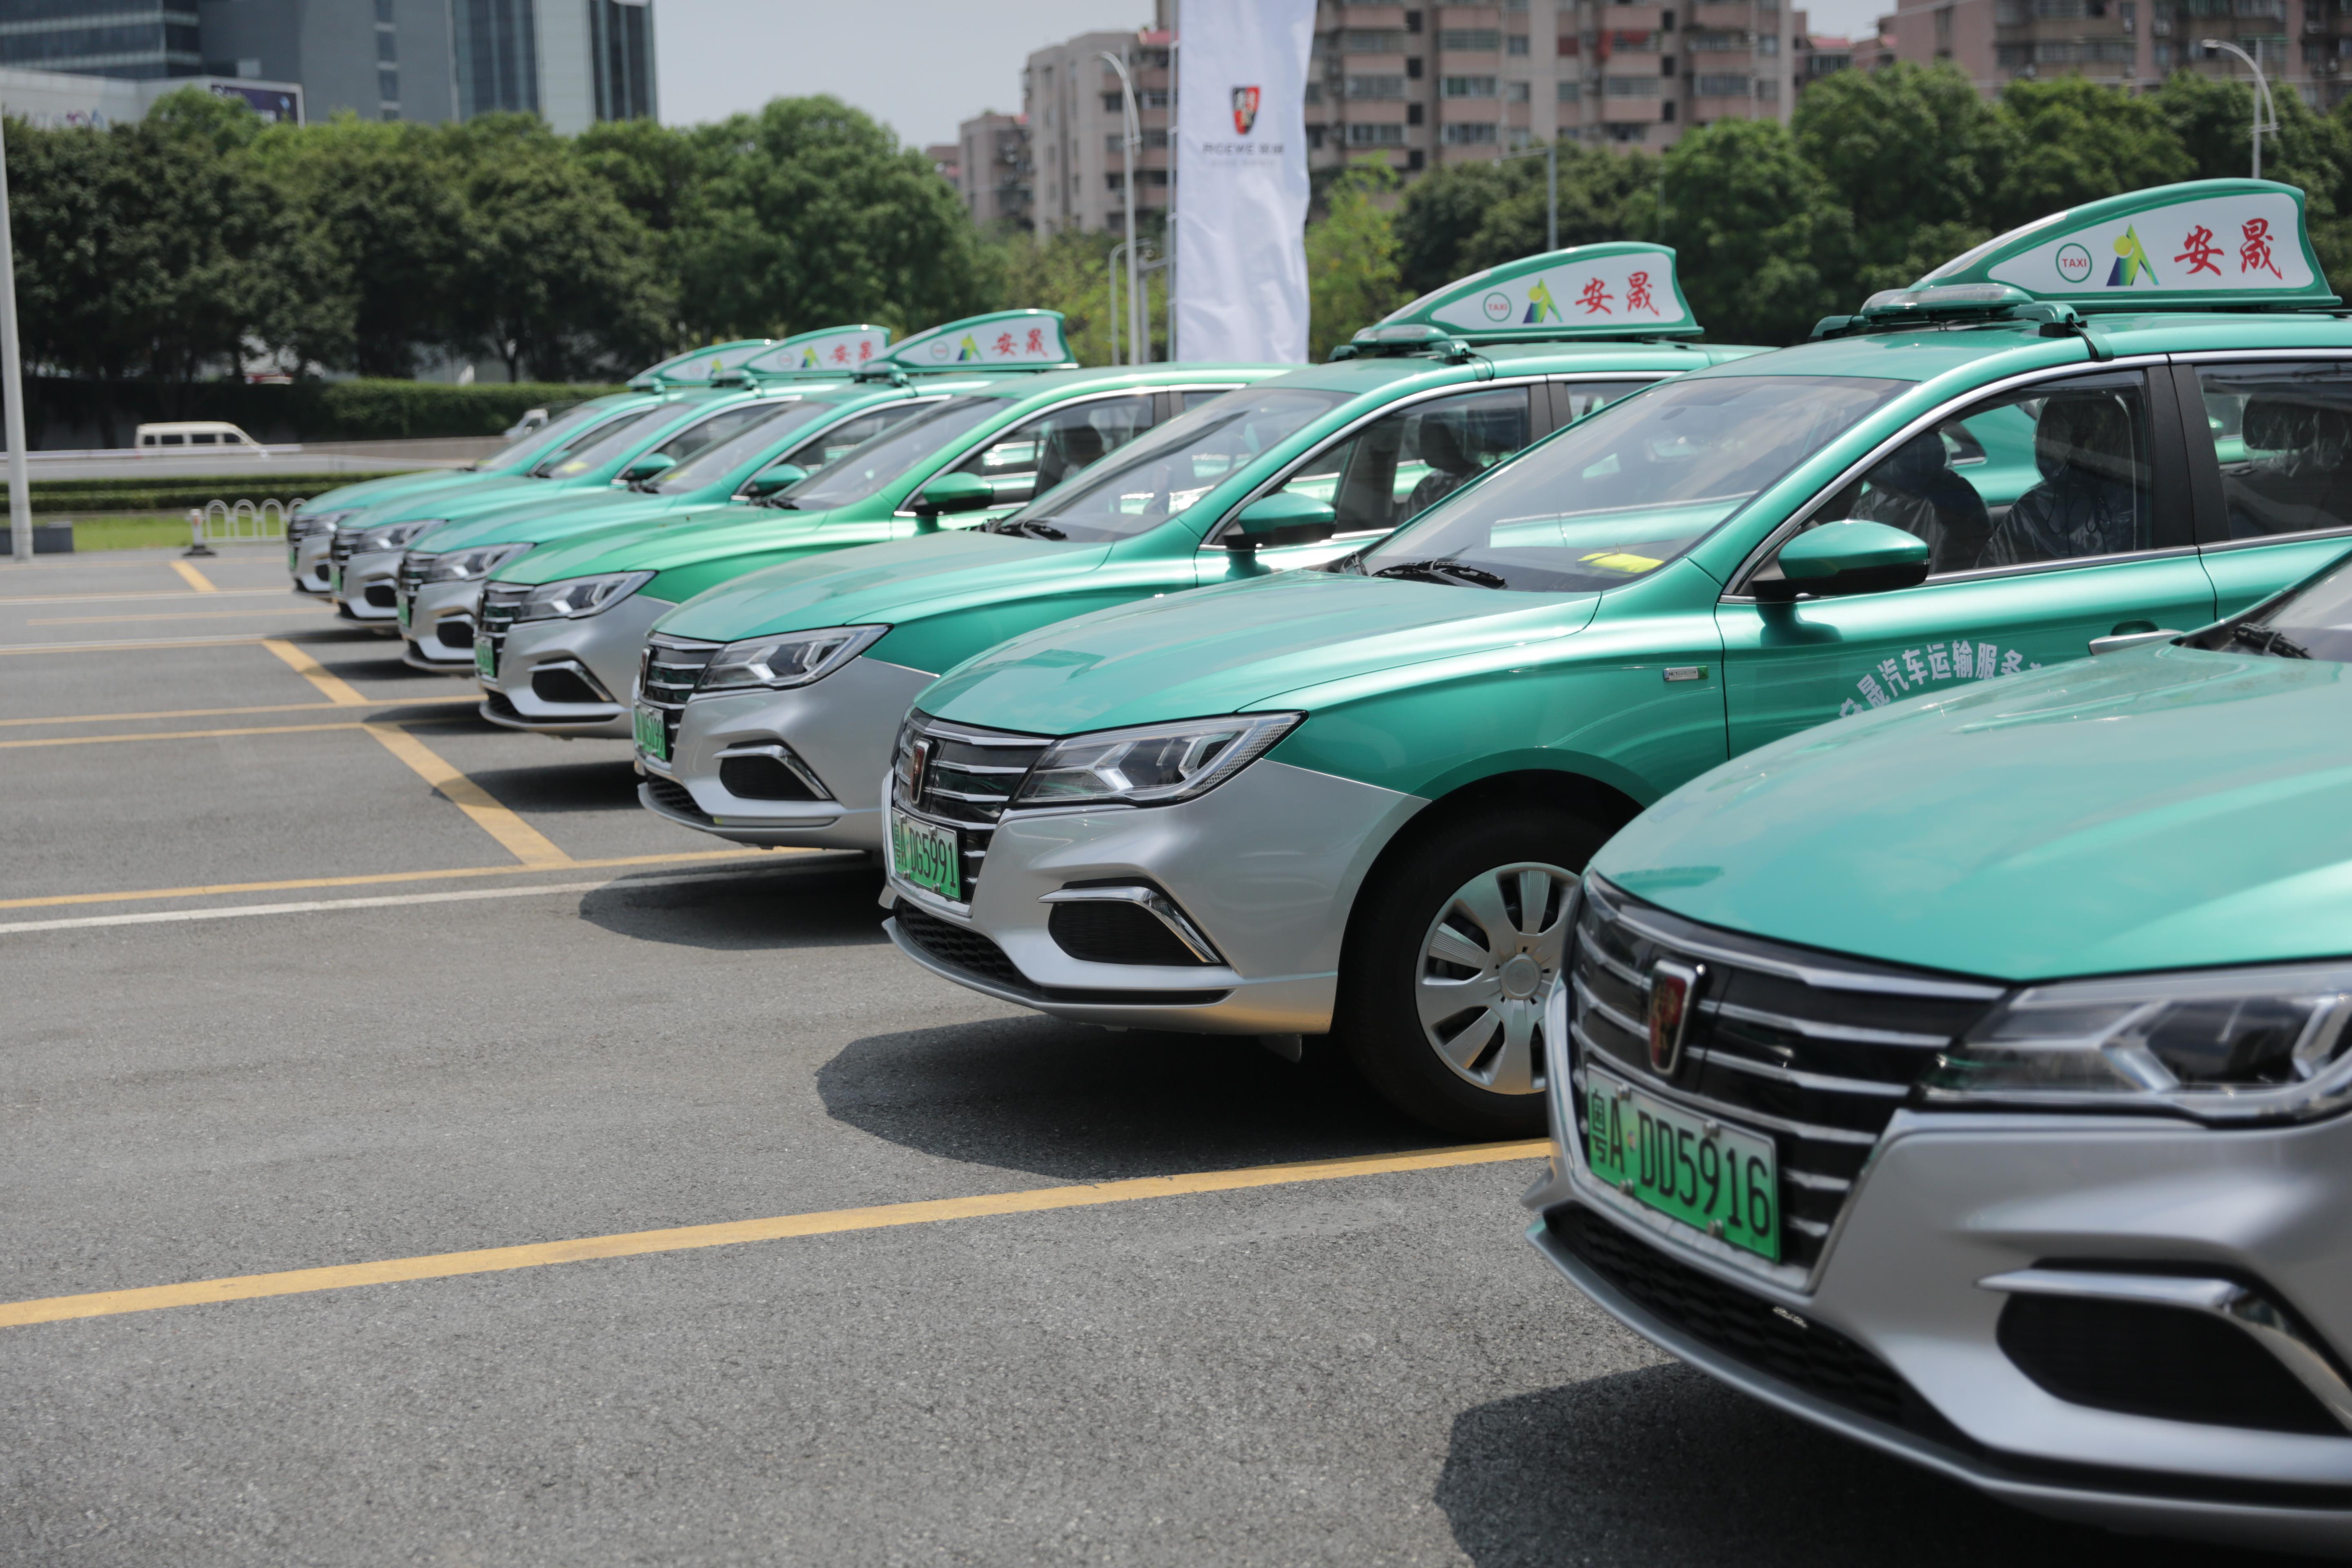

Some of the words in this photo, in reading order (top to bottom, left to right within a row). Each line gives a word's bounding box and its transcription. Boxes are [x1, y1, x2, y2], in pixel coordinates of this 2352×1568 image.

[2062, 258, 2087, 267] TAXI
[2174, 218, 2283, 280] 安晟
[1575, 271, 1660, 316] 安晟
[1839, 640, 2041, 718] 晟汽车运输服务
